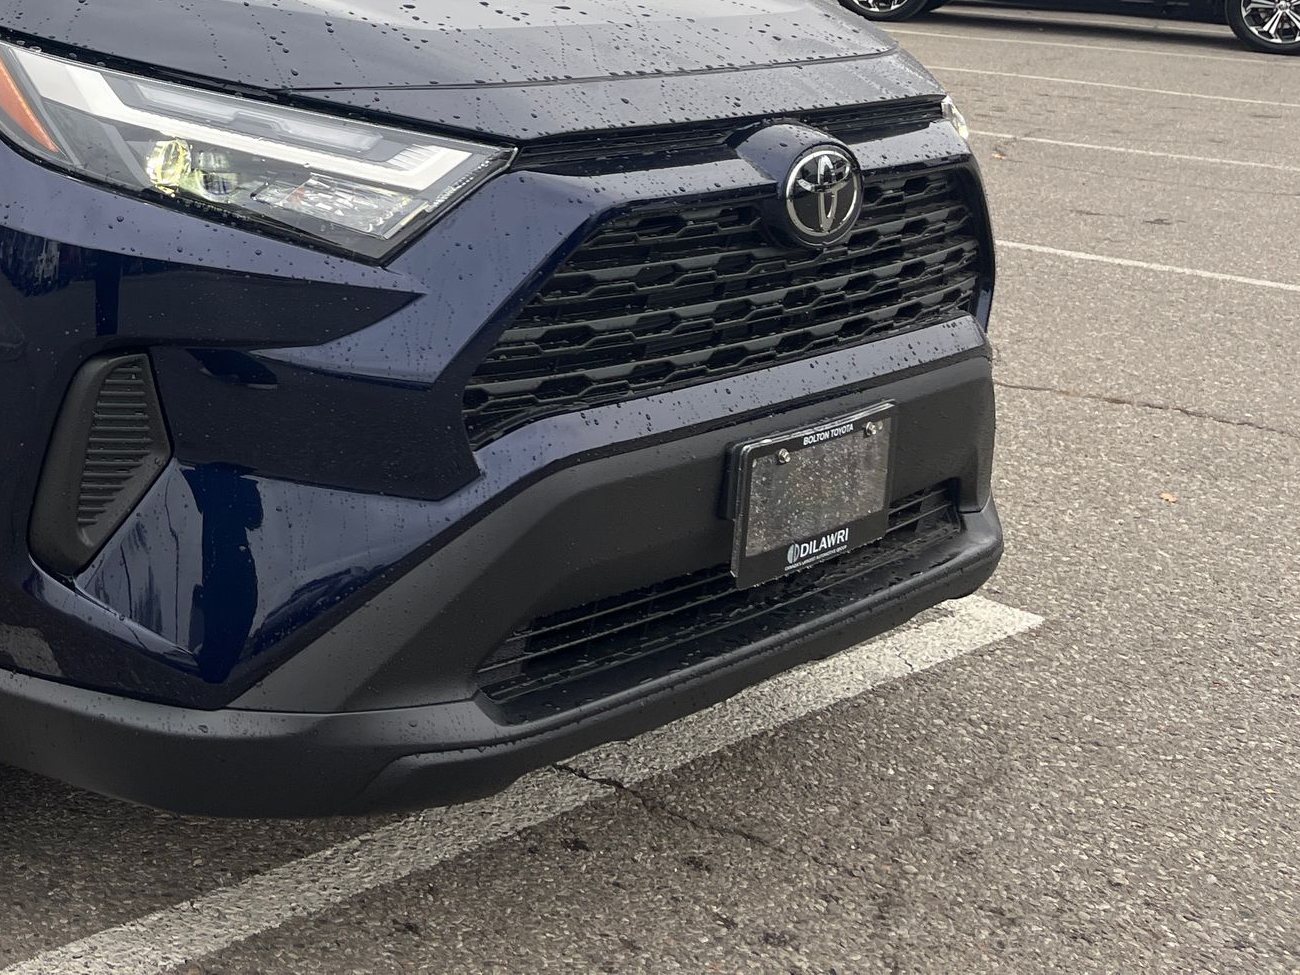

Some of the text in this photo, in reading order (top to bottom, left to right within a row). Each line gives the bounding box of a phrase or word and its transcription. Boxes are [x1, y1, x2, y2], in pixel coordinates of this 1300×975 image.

[803, 423, 854, 446] BOLTON TOYOTA
[800, 528, 849, 558] DILAWRI
